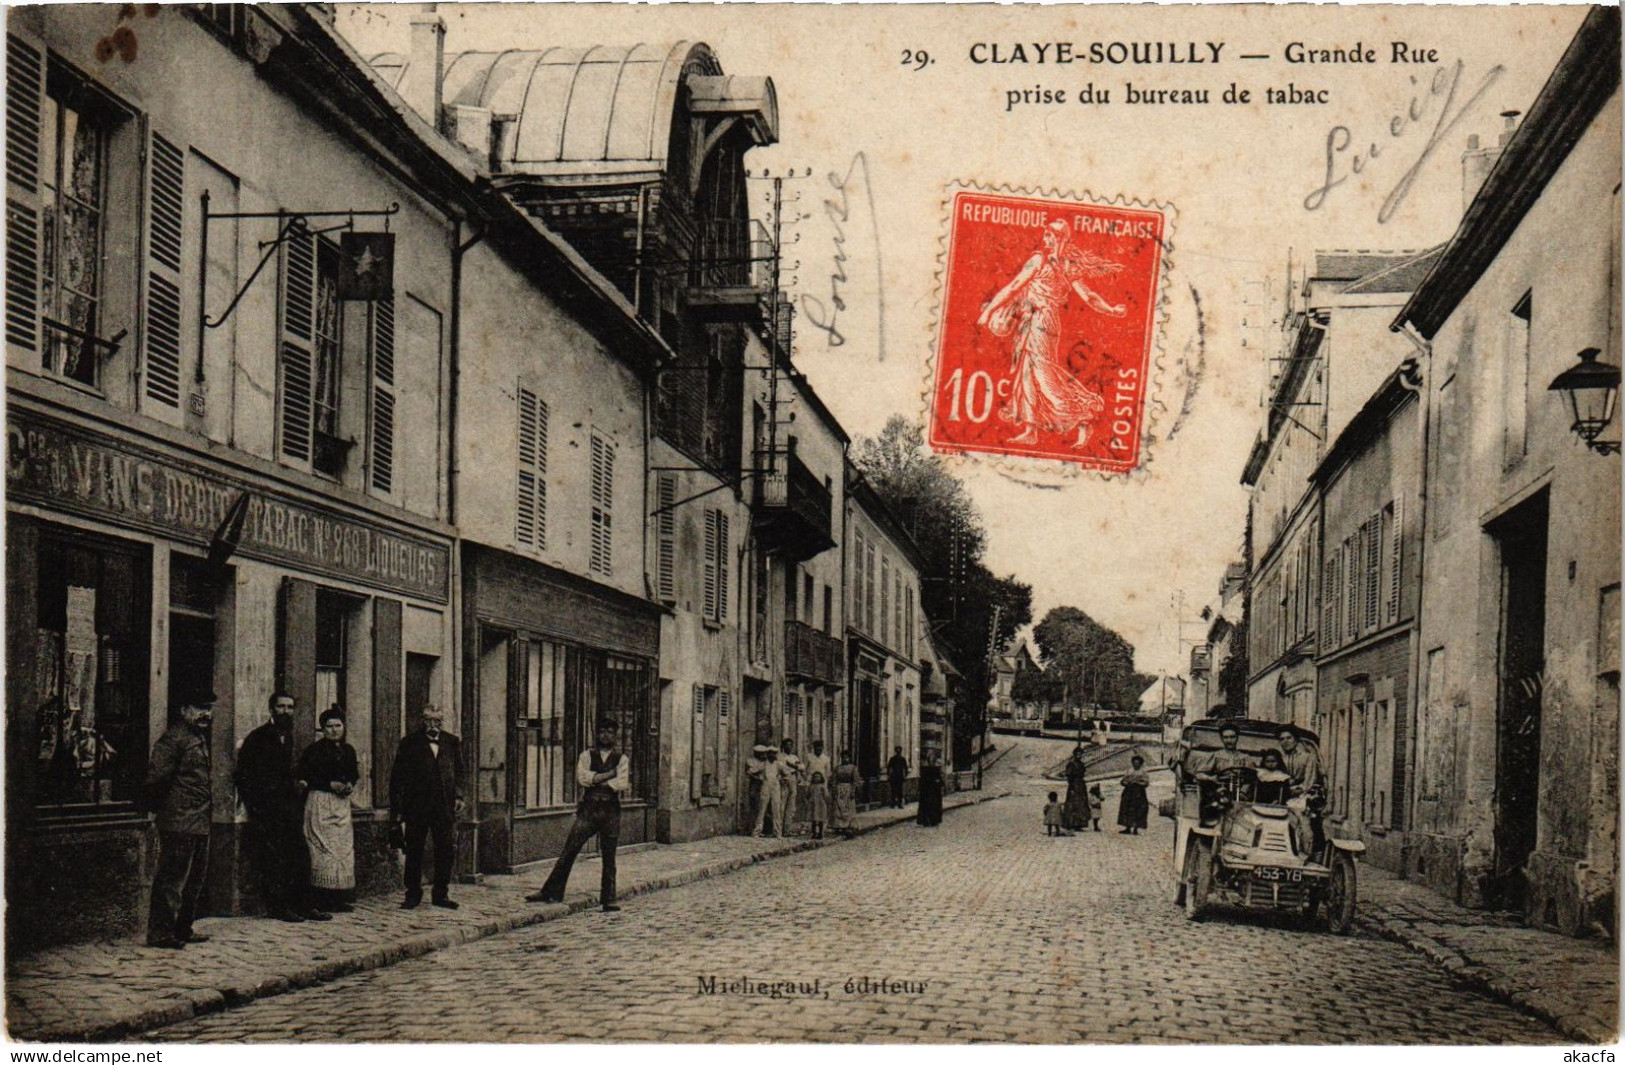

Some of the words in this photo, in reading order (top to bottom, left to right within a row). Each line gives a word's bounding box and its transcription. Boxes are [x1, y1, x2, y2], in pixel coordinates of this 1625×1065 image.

[962, 202, 1048, 229] REPUBLIQUE
[1073, 214, 1154, 240] FRANÇAISE
[1110, 367, 1138, 452] POSTES
[71, 443, 154, 515] VINS
[247, 496, 309, 554] TABAC
